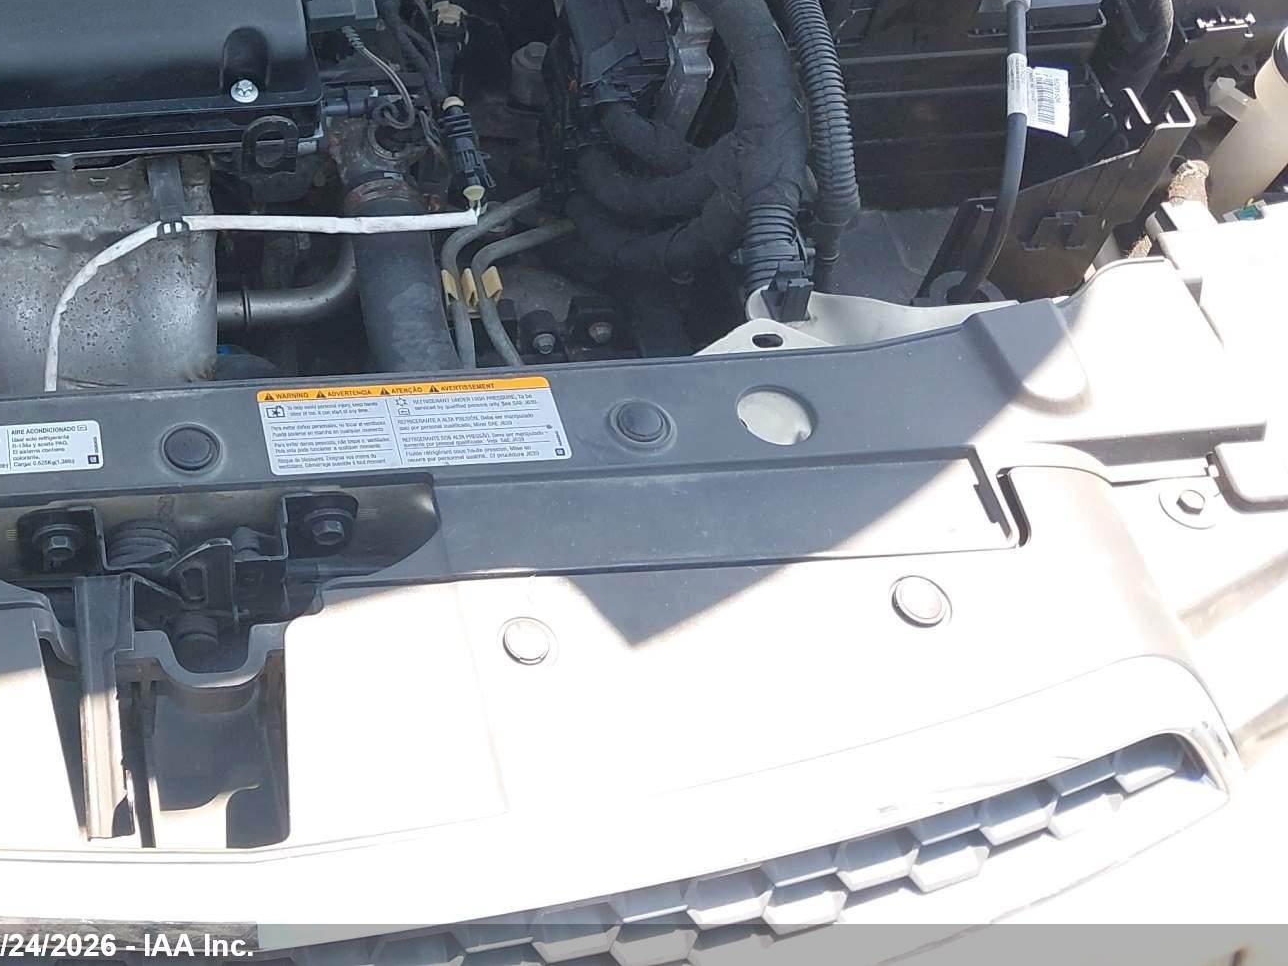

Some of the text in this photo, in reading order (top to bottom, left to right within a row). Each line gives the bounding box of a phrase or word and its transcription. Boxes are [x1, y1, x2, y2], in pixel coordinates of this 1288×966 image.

[275, 392, 309, 400] WARNING
[392, 385, 423, 394] ATENÇÃO
[440, 382, 495, 392] AVERTISSEMENT
[26, 426, 75, 434] ACONDICIONADO
